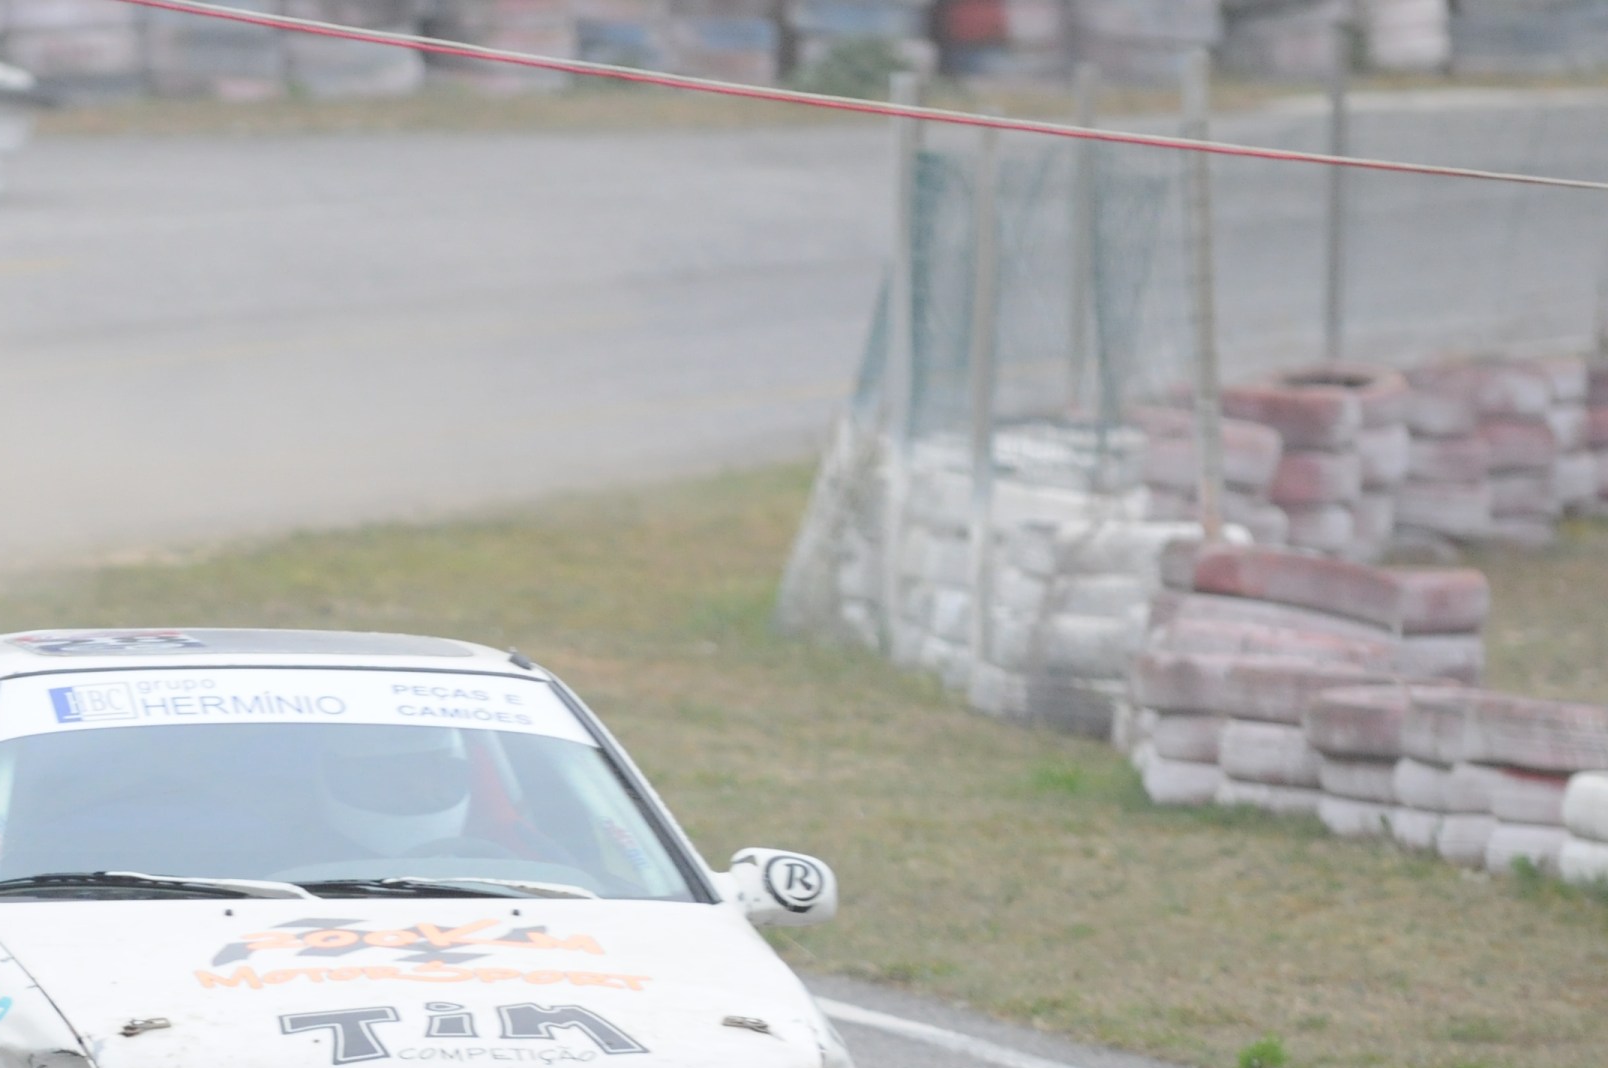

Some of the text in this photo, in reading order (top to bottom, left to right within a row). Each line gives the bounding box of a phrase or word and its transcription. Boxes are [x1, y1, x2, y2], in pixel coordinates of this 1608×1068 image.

[137, 679, 215, 694] grupo
[392, 684, 524, 706] PEÇAS E
[141, 691, 347, 716] HERMÍNIO
[397, 1046, 597, 1065] COMPETIÇÃO
